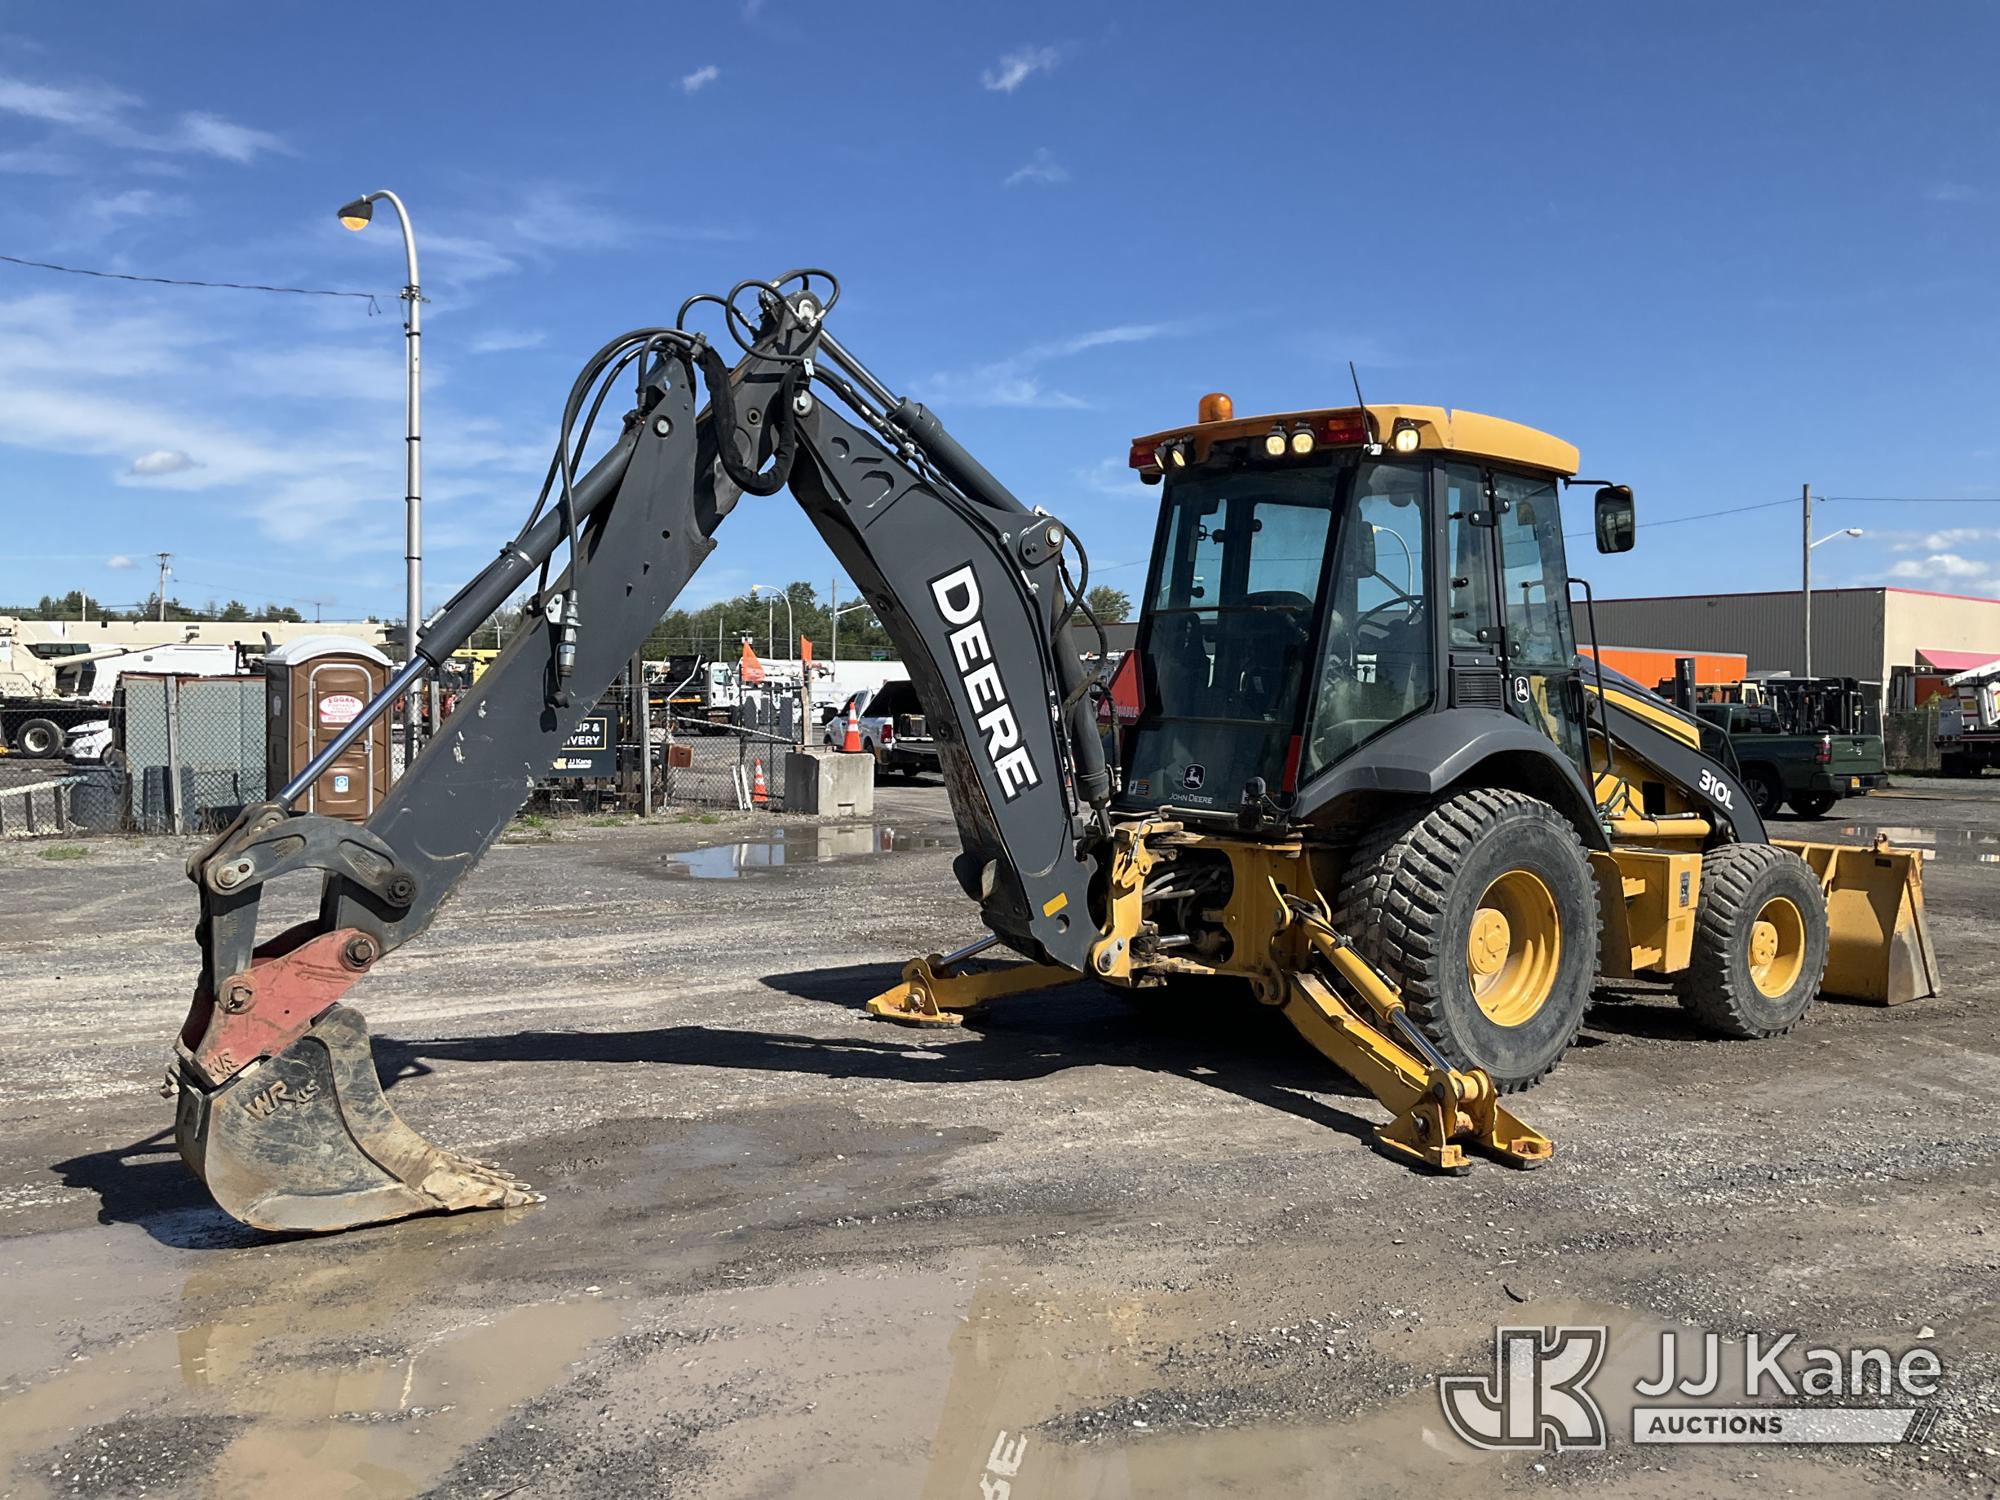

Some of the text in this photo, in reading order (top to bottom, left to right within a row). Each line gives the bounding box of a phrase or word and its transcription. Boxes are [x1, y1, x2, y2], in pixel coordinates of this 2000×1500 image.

[931, 565, 1038, 799] DEERE
[566, 735, 600, 745] IVERY
[1168, 793, 1213, 804] JOHN DEERE
[1699, 769, 1734, 810] 310L
